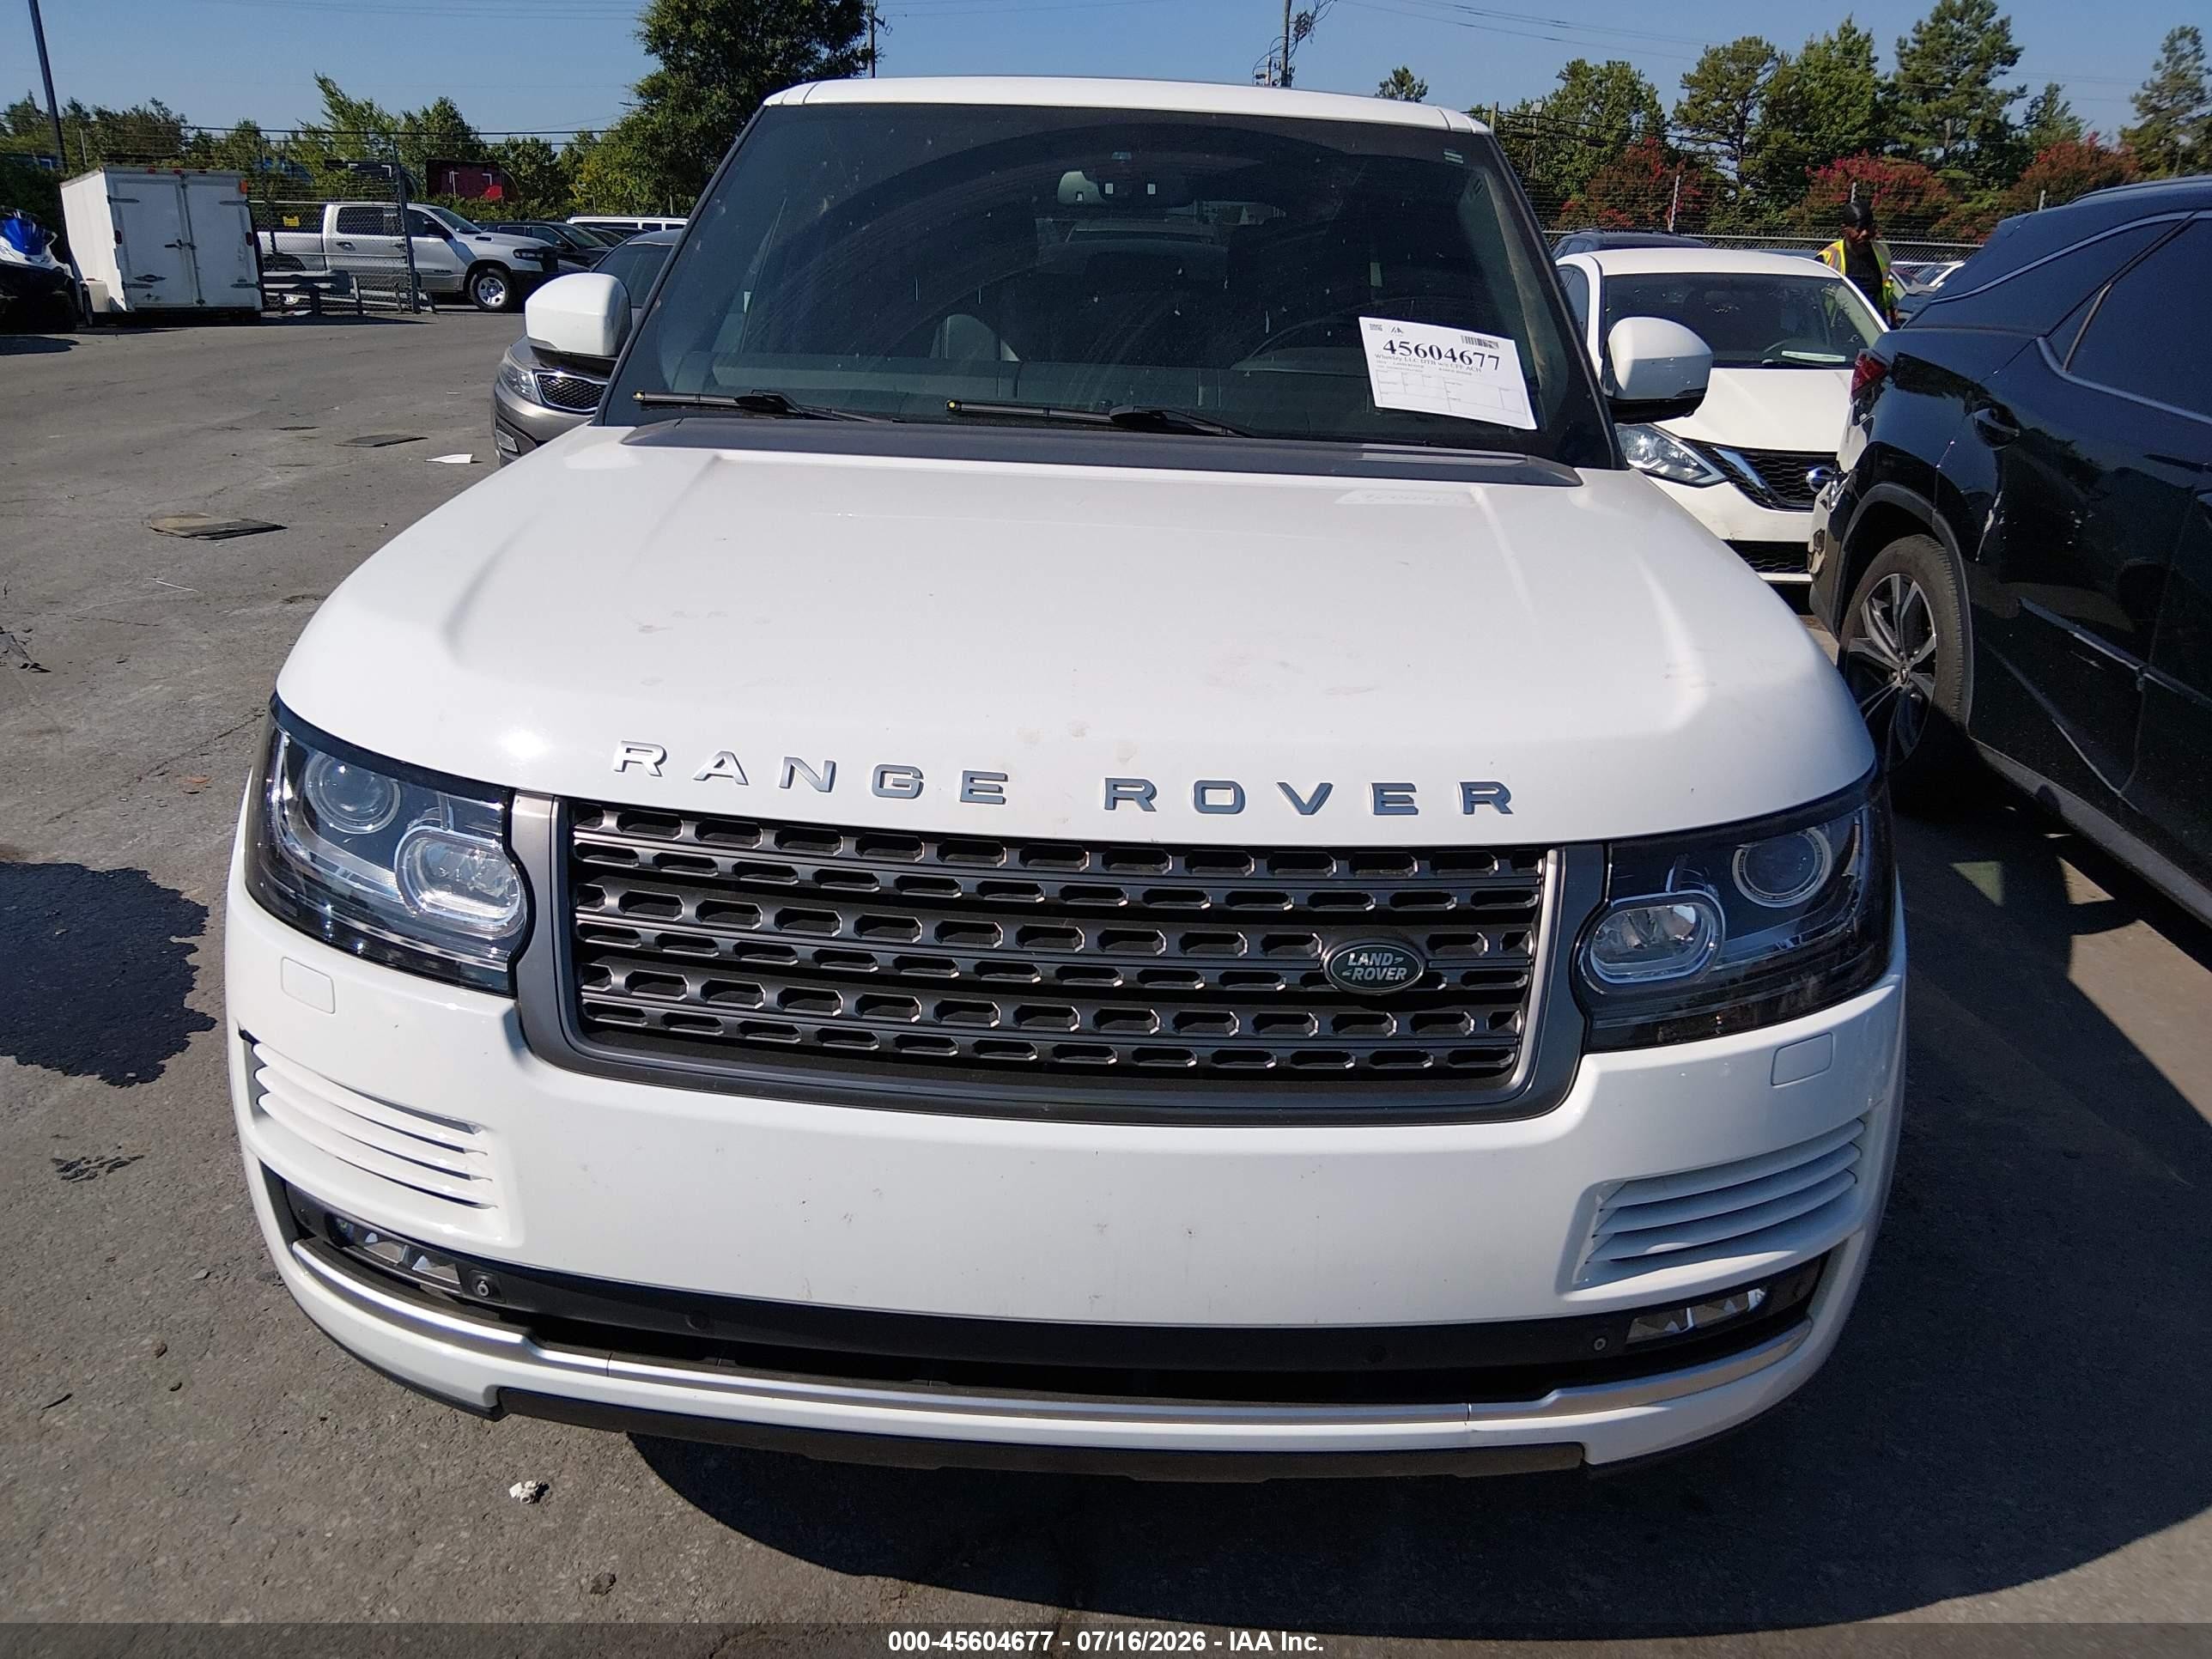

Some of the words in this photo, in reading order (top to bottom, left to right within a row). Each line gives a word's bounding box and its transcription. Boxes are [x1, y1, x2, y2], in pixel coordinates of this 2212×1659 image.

[1382, 339, 1500, 371] 45604677
[613, 739, 1010, 804] RANGE
[1103, 776, 1515, 816] ROVER
[1347, 952, 1393, 966] LAND
[1352, 967, 1408, 981] ROVER
